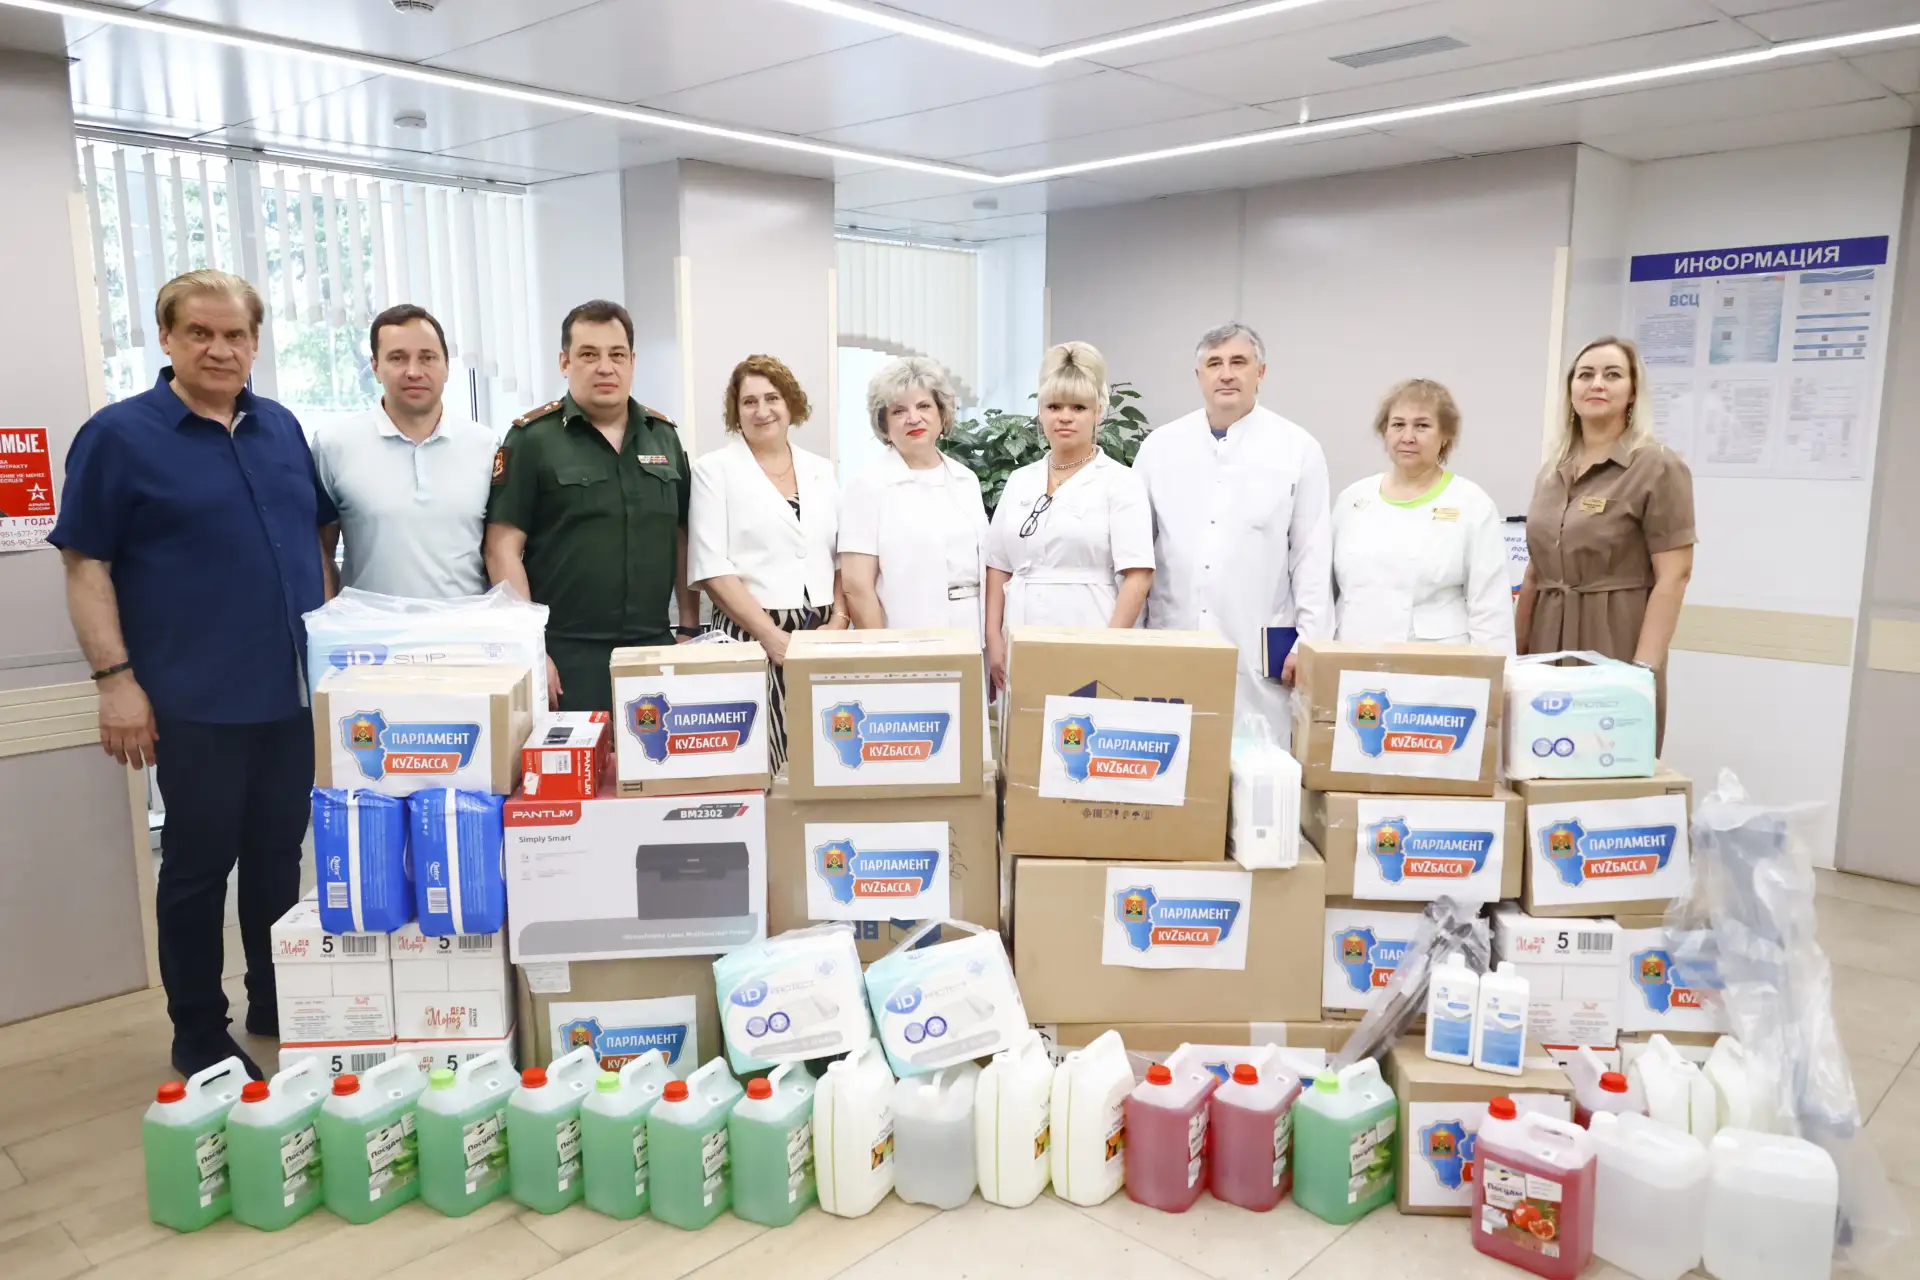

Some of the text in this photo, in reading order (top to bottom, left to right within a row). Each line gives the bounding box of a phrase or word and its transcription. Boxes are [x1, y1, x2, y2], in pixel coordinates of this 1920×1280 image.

[1674, 245, 1840, 274] ИНФОРМАЦИЯ
[1669, 293, 1700, 307] ВСЦ
[0, 433, 45, 453] МЫЕ.
[24, 518, 54, 526] ГОДА
[394, 653, 446, 664] SLIP
[1543, 694, 1563, 710] iD
[674, 709, 748, 725] ПАРЛАМЕНТ
[1393, 711, 1466, 729] ПАРЛАМЕНТ
[869, 720, 941, 734] ПАРЛАМЕНТ
[391, 730, 470, 746] ПАРЛАМЕНТ
[674, 734, 728, 750] КУZБАССА
[1097, 737, 1170, 754] ПАРЛАМЕНТ
[1391, 735, 1443, 751] КУZБАССА
[869, 744, 921, 757] КУZБАССА
[391, 754, 448, 770] КУZБАССА
[1096, 759, 1148, 775] КУZБАССА
[512, 810, 573, 819] PANTUM
[680, 809, 723, 818] BM2302
[1412, 837, 1485, 852] ПАРЛАМЕНТ
[1588, 834, 1667, 851] ПАРЛАМЕНТ
[859, 858, 930, 871] ПАРЛАМЕНТ
[1410, 861, 1463, 875] КУZБАССА
[1590, 858, 1647, 874] КУZБАССА
[860, 879, 911, 893] КУZБАССА
[1159, 906, 1231, 921] ПАРЛАМЕНТ
[439, 935, 450, 950] 5
[1158, 929, 1209, 943] КУZБАССА
[1557, 932, 1569, 949] 5
[323, 936, 334, 953] 5
[741, 989, 760, 1004] iD
[896, 995, 915, 1010] iD
[425, 1006, 463, 1029] Мороз
[450, 1006, 466, 1015] ДЕД
[606, 1033, 678, 1048] ПАРЛАМЕНТ
[331, 1055, 343, 1072] 5
[447, 1055, 458, 1071] 5
[560, 1132, 581, 1150] Посуд
